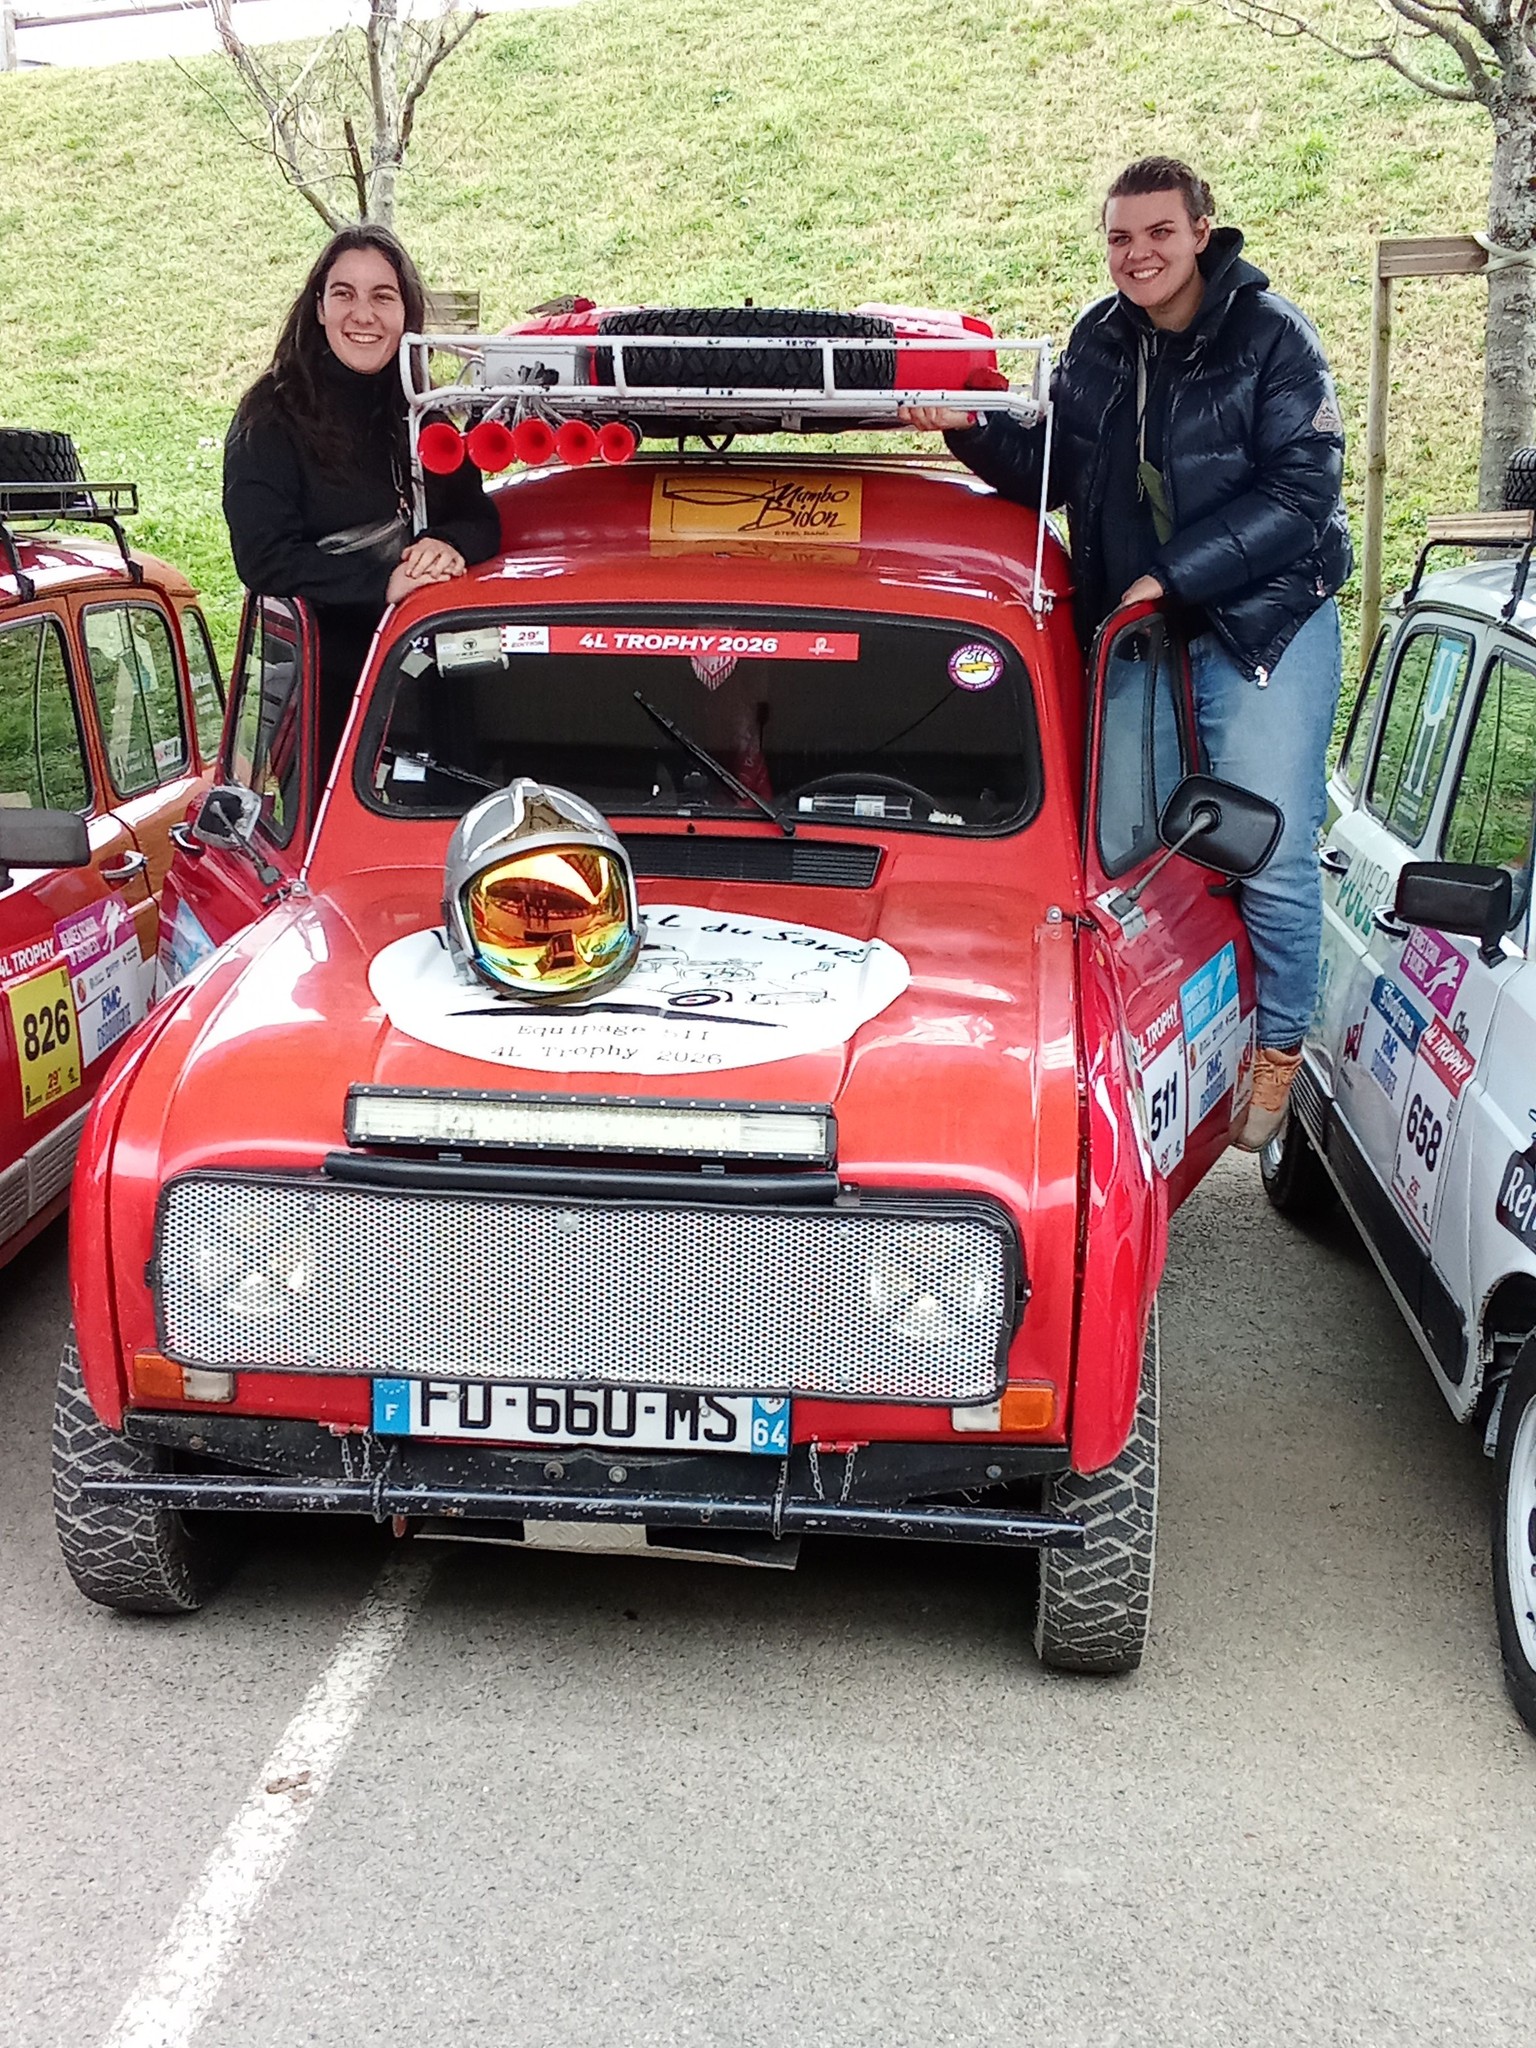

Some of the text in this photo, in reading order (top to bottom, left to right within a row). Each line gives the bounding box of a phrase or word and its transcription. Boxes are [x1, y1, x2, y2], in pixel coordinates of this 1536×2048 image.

[738, 494, 846, 532] Bidon
[579, 633, 779, 652] 4L TROPHY 2026
[700, 922, 752, 936] du
[10, 938, 55, 972] TROPHY
[23, 999, 70, 1061] 826
[518, 1025, 646, 1037] Equipage
[1146, 1000, 1178, 1048] TROPHY
[490, 1044, 722, 1065] 4L Trophy 2026
[1435, 1032, 1471, 1080] TROPHY
[1150, 1071, 1178, 1141] 511
[1407, 1093, 1442, 1172] 658
[385, 1404, 398, 1421] F
[753, 1417, 787, 1448] 64
